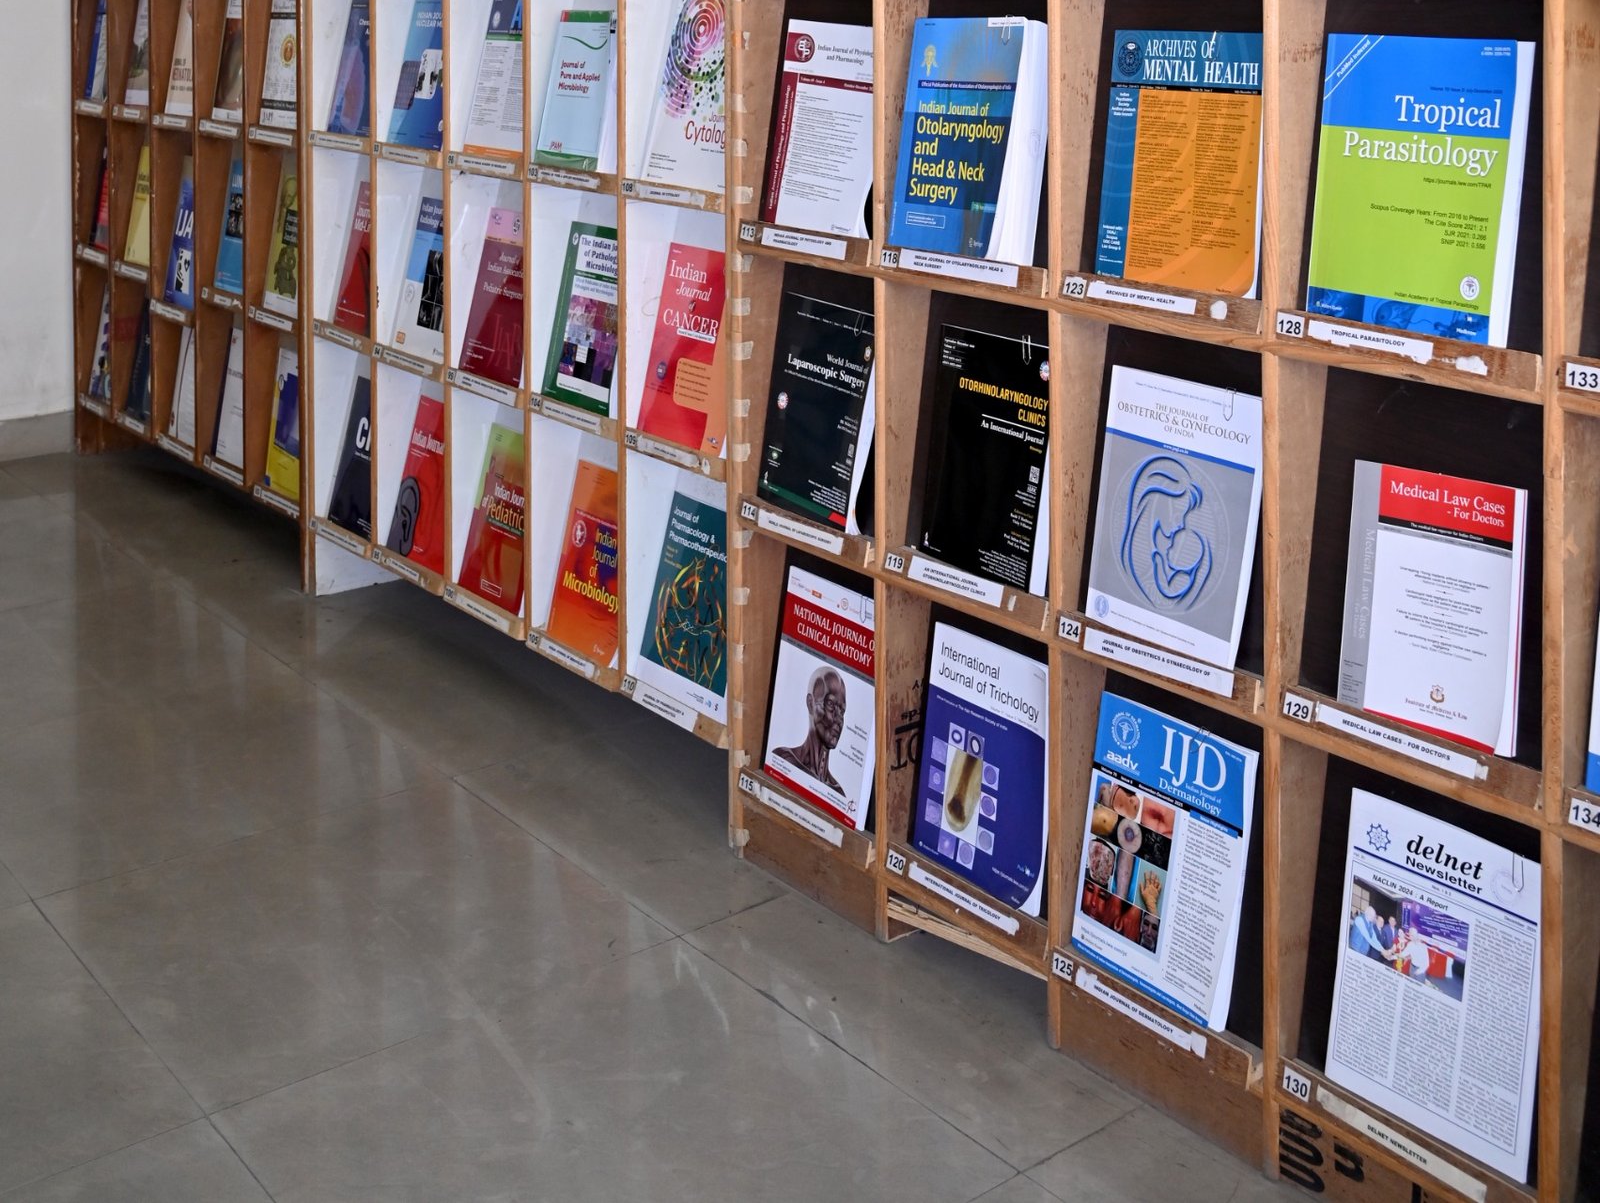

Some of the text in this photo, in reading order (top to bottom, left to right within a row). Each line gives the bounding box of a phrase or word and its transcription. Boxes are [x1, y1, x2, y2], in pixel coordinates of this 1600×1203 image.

[1145, 39, 1216, 59] ARCHIVES OF
[1143, 59, 1259, 85] MENTAL HEALTH
[918, 100, 989, 117] Indian Journal of
[1395, 95, 1501, 132] Tropical
[917, 116, 1004, 144] Otolaryngology
[914, 138, 937, 156] and
[1343, 131, 1498, 176] Parasitology
[912, 160, 984, 182] Head & Neck
[909, 178, 958, 205] Surgery
[742, 227, 754, 238] 113
[882, 251, 897, 264] 118
[670, 259, 707, 284] Indian
[676, 284, 712, 301] Journal
[1065, 282, 1084, 295] 123
[663, 308, 719, 336] CANCER
[1278, 320, 1301, 334] 128
[1331, 329, 1405, 347] TROPICAL PARASITOLOGY
[788, 353, 866, 391] Laparoscopic Surgery
[1568, 370, 1598, 388] 133
[959, 377, 1049, 412] OTORHINOLARYNGOLOGY
[1018, 409, 1046, 427] CLINICS
[1117, 401, 1251, 445] OBSTETRICS & GYNECOLOGY
[1155, 403, 1209, 422] THE JOURNAL OF
[990, 421, 1045, 446] International Journal
[1164, 424, 1194, 439] OF INDIA
[1390, 480, 1505, 515] Medical Law Cases
[742, 504, 756, 517] 114
[1453, 507, 1505, 527] For Doctors
[886, 554, 903, 570] 119
[794, 603, 868, 648] NATIONAL JOURNAL
[1060, 622, 1079, 638] 124
[797, 623, 872, 667] CLINICAL ANATOMY
[940, 642, 1001, 681] International
[939, 662, 1040, 723] Journal of Trichology
[1285, 701, 1309, 719] 129
[1342, 719, 1451, 761] MEDICAL LAW CASES FOR DOCTORS
[1106, 750, 1139, 771] aadv
[1160, 725, 1227, 792] IJD
[740, 776, 753, 791] 115
[1158, 777, 1222, 817] Dermatology
[888, 854, 904, 871] 120
[1406, 834, 1483, 880] delnet
[1406, 855, 1483, 894] Newsletter
[1054, 959, 1072, 976] 125
[1284, 1075, 1308, 1098] 130
[1367, 1124, 1388, 1139] DELNET
[1390, 1136, 1428, 1165] NEWSLETTER
